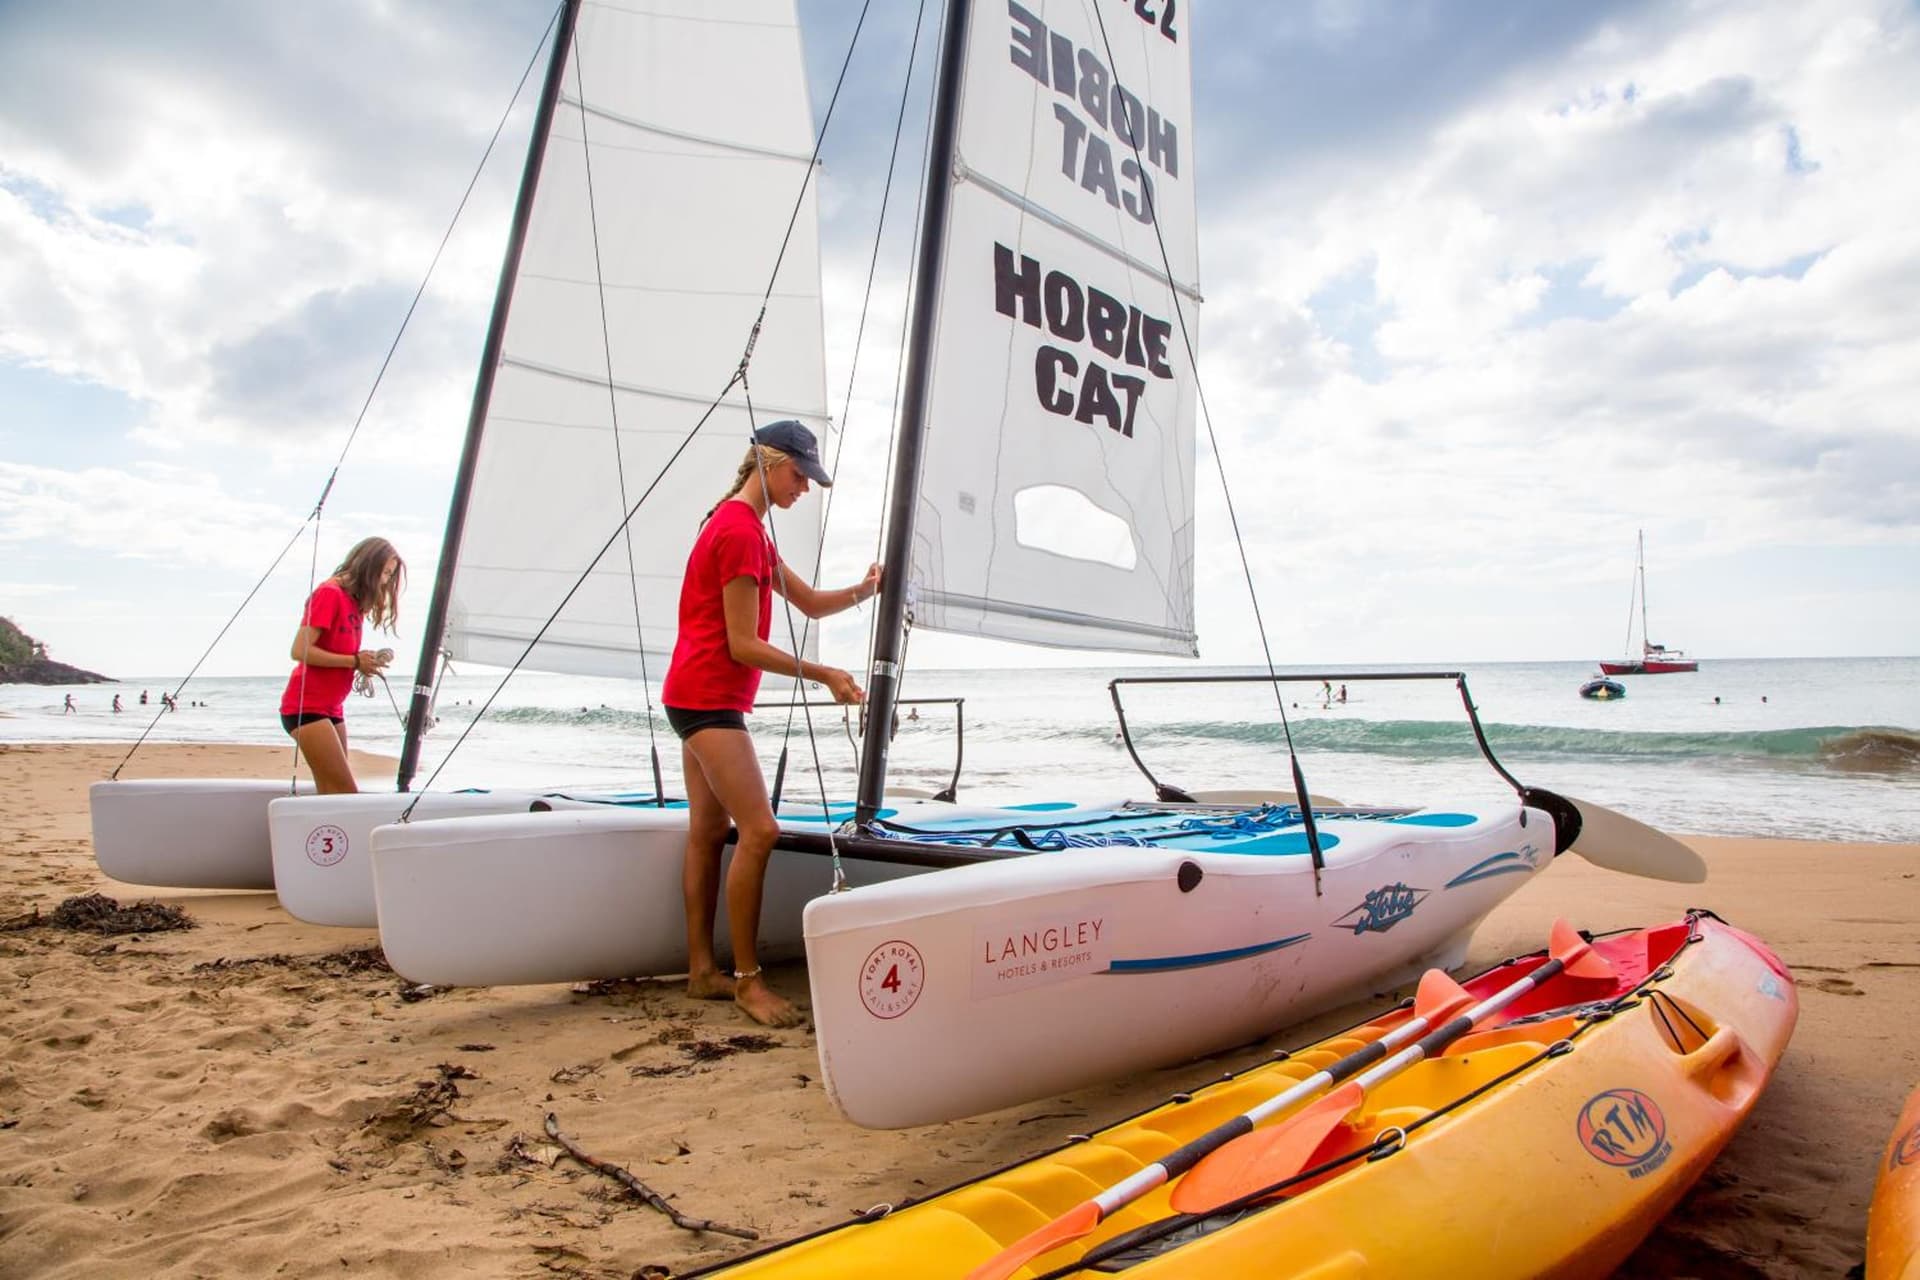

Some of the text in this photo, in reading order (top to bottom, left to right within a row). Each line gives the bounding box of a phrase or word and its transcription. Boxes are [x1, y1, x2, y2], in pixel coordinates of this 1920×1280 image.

[994, 241, 1174, 379] HOBIE
[1035, 345, 1146, 439] CAT
[322, 837, 333, 854] 3
[985, 918, 1104, 963] LANGLEY
[866, 947, 918, 980] FORT ROYAL
[881, 963, 902, 993] 4
[998, 952, 1092, 980] HOTELS & RESORTS
[1591, 1095, 1656, 1157] RTM
